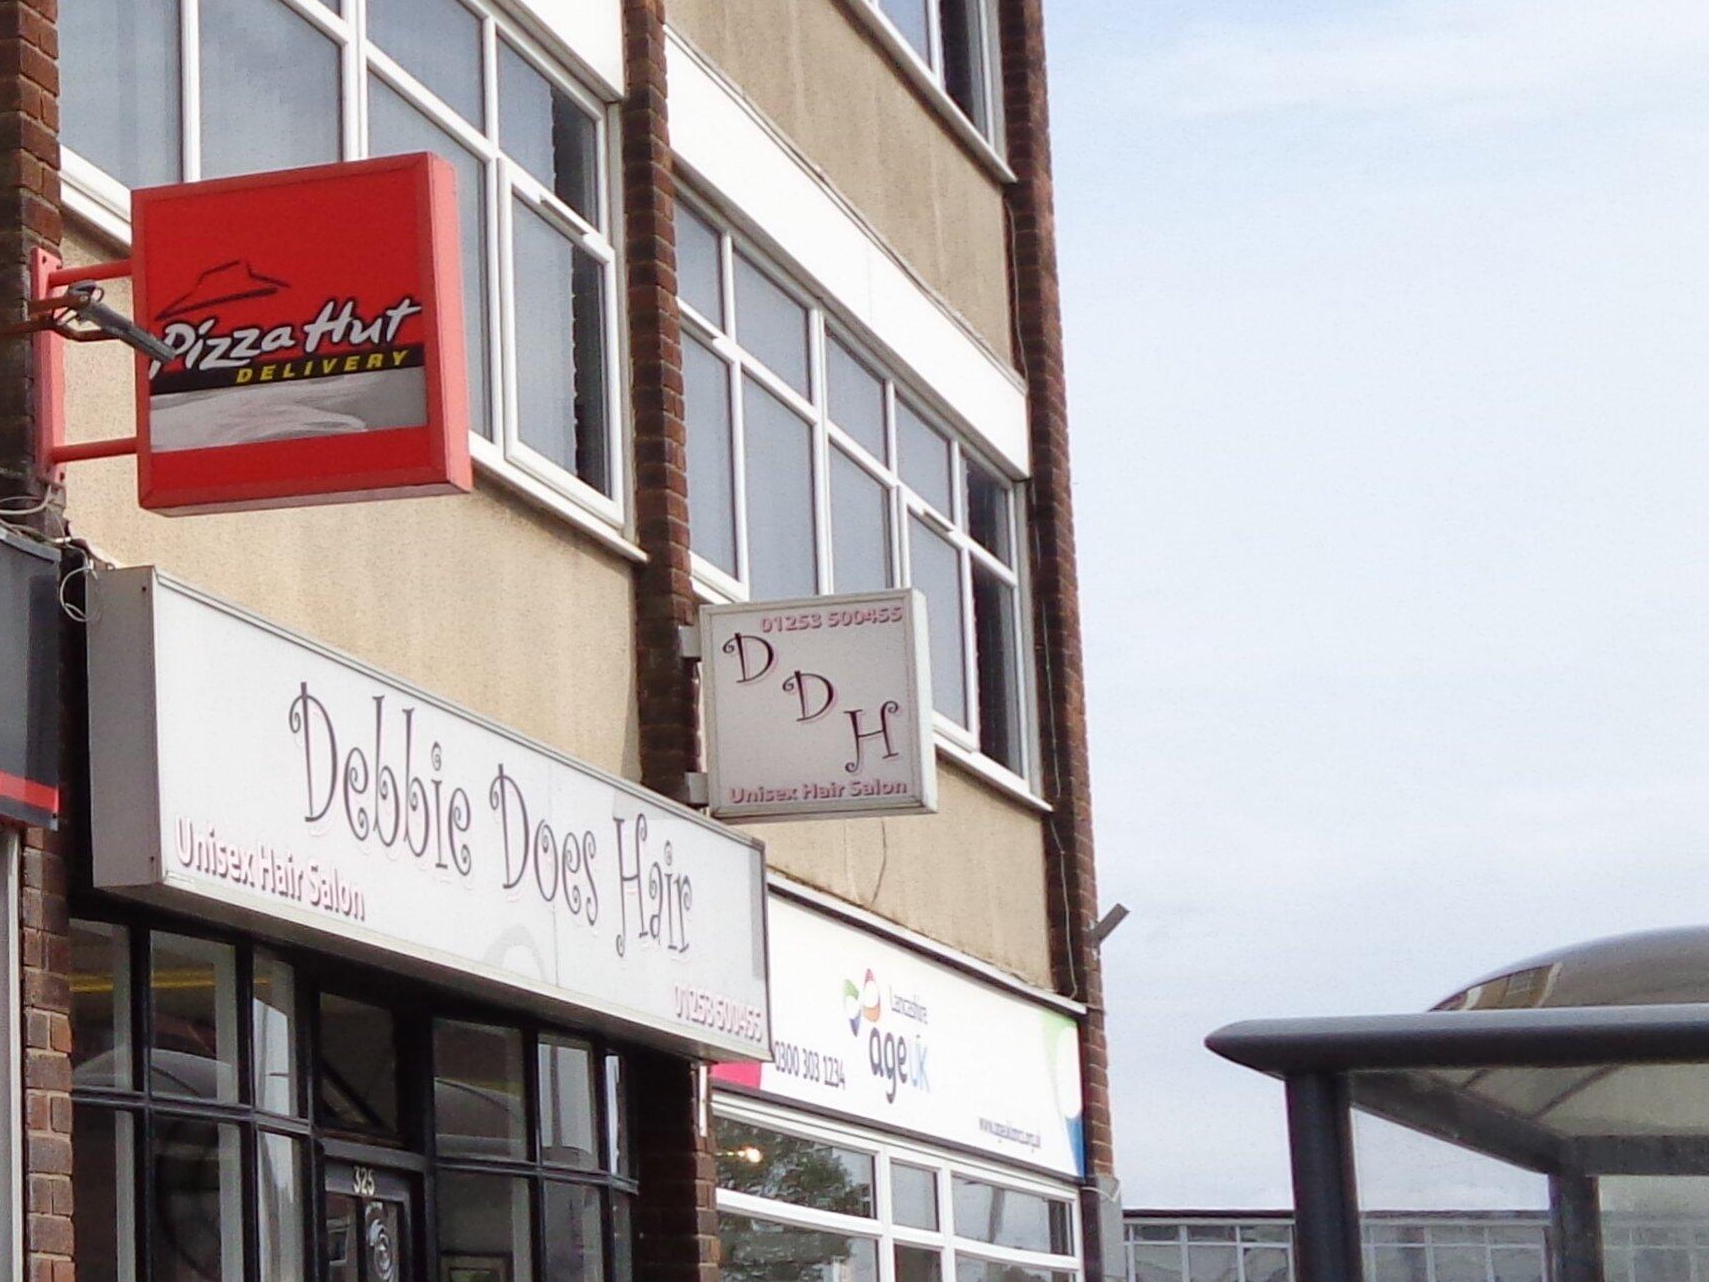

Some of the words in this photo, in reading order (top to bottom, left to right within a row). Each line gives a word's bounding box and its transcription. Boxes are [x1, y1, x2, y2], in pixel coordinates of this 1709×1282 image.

[148, 319, 295, 380] Pizza
[303, 297, 423, 356] Hut
[235, 349, 409, 385] DELIVERY
[722, 632, 774, 684] D
[782, 670, 835, 721] D
[844, 699, 900, 774] H
[288, 680, 473, 877] Debbie
[488, 762, 599, 928] Does
[613, 812, 694, 958] Hair
[728, 785, 798, 804] Unisex
[802, 781, 846, 801] Hair
[848, 777, 908, 797] Salon
[175, 816, 257, 888] Unisex
[258, 839, 306, 903] Hair
[308, 852, 367, 922] Salon
[775, 1041, 800, 1078] 0300
[802, 1048, 820, 1083] 303
[824, 1054, 846, 1091] 1234
[869, 1027, 907, 1104] age
[353, 1165, 375, 1196] 325
